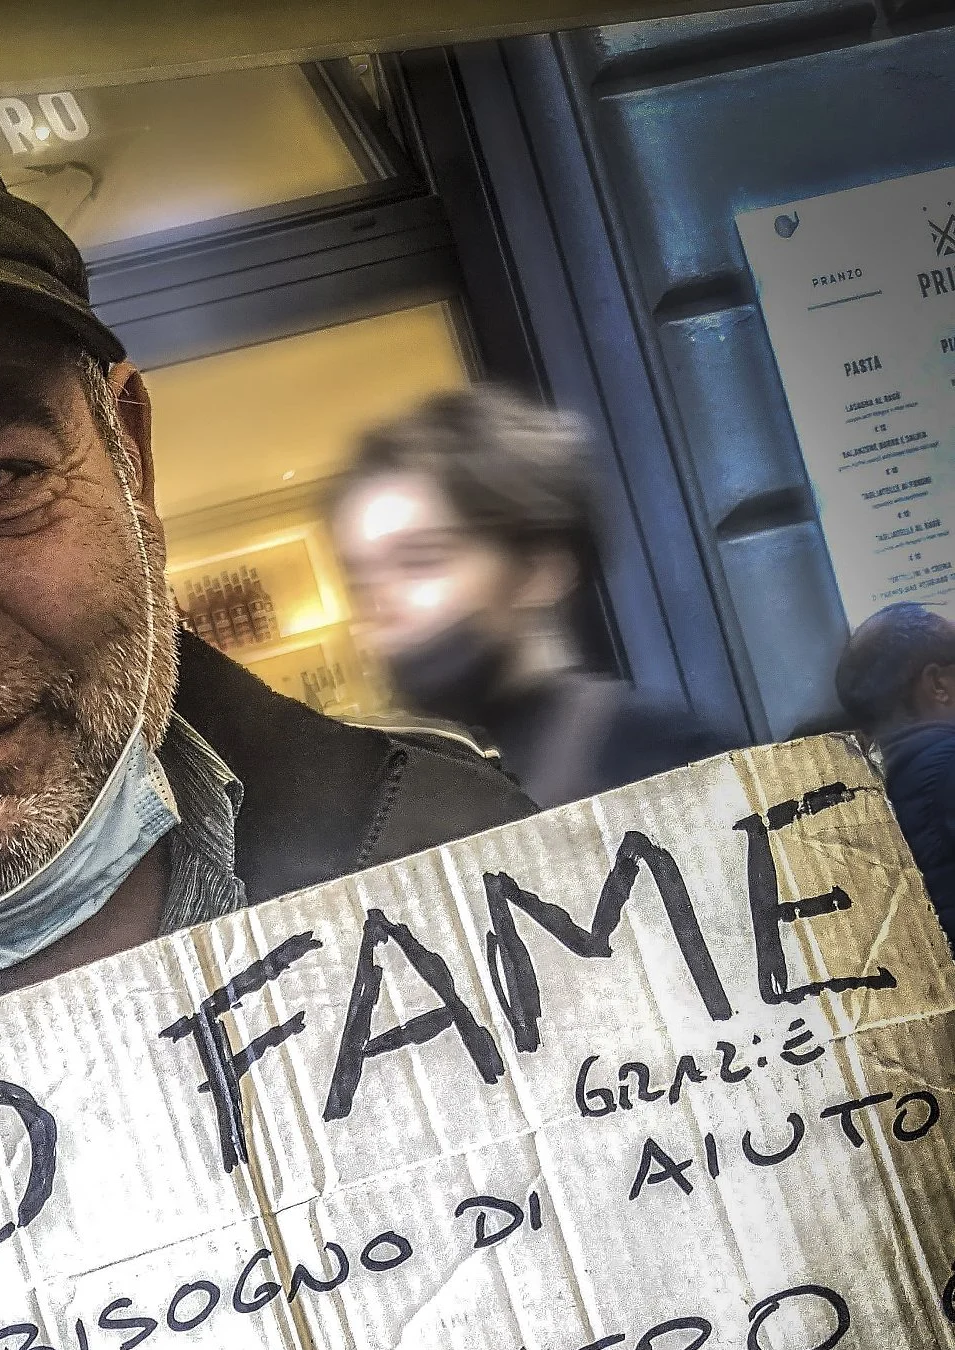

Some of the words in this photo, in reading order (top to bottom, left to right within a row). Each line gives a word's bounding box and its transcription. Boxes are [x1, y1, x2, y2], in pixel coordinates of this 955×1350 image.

[812, 268, 863, 288] PRANZO
[917, 266, 955, 298] PRI
[844, 355, 882, 377] PASTA
[158, 782, 899, 1173] FAME
[455, 1191, 544, 1249] DI
[629, 1091, 940, 1201] AIUTO
